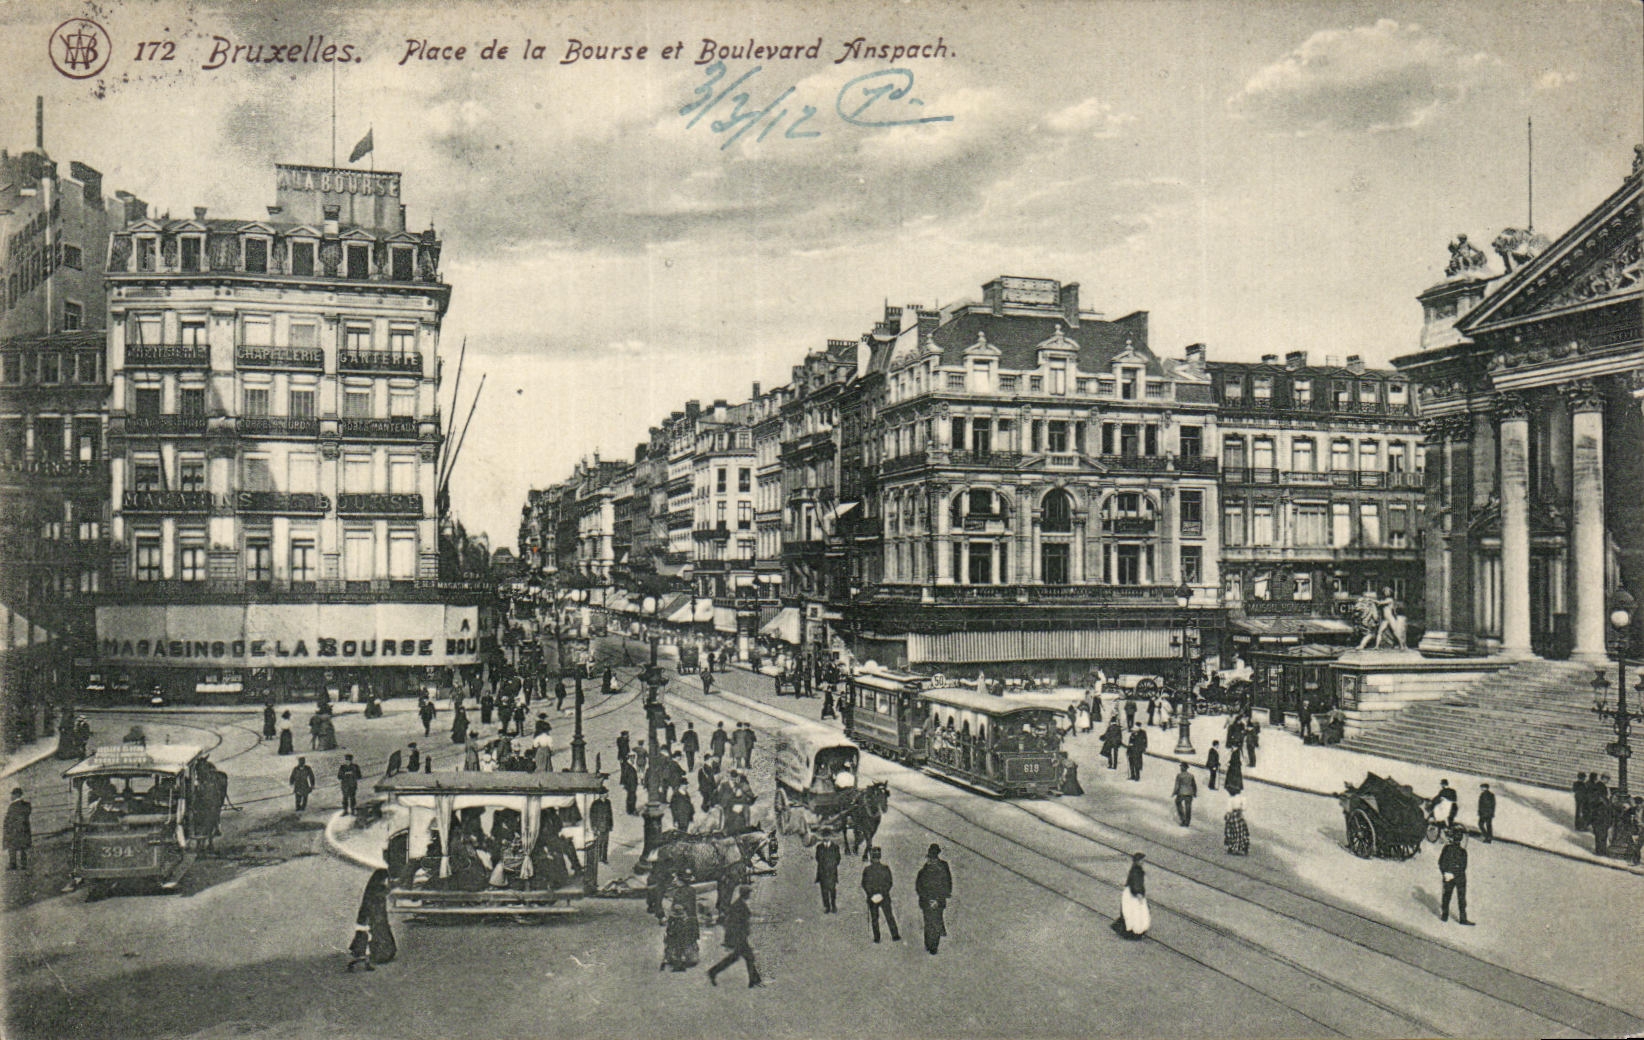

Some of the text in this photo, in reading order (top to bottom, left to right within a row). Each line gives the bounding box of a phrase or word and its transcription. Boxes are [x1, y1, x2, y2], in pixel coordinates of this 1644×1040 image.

[320, 173, 400, 197] BOURSE
[237, 349, 322, 362] CHAPELLERIE
[340, 350, 418, 366] GANTERIE
[315, 494, 419, 511] BOURSE
[103, 637, 433, 658] MAGASINS DE LA BOURSE
